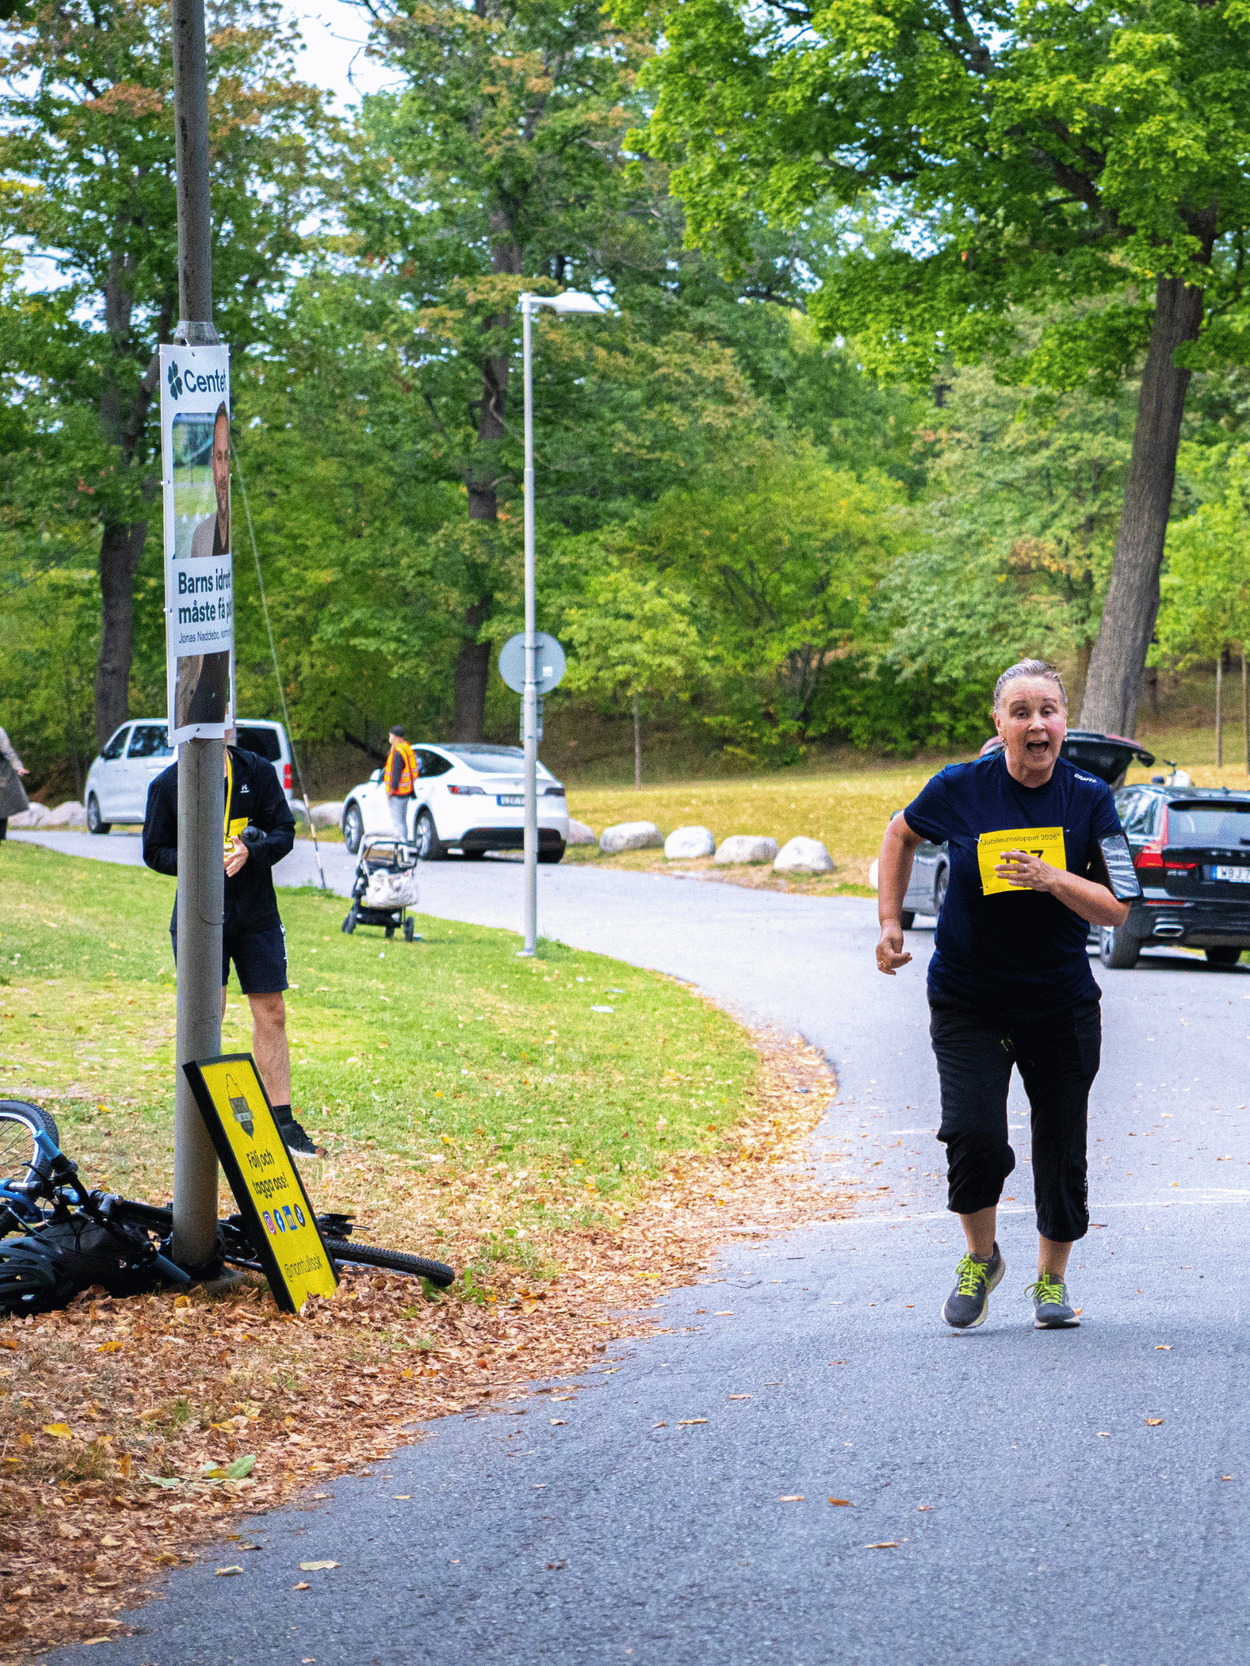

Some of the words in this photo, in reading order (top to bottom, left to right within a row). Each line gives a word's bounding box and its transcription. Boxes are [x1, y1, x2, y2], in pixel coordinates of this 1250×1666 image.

[178, 571, 213, 594] Barns
[178, 599, 216, 624] måste
[218, 596, 225, 620] få
[178, 632, 197, 644] Jonas
[246, 1150, 264, 1173] Följ
[260, 1148, 275, 1166] och
[251, 1179, 275, 1199] tagga
[272, 1171, 289, 1190] oss!
